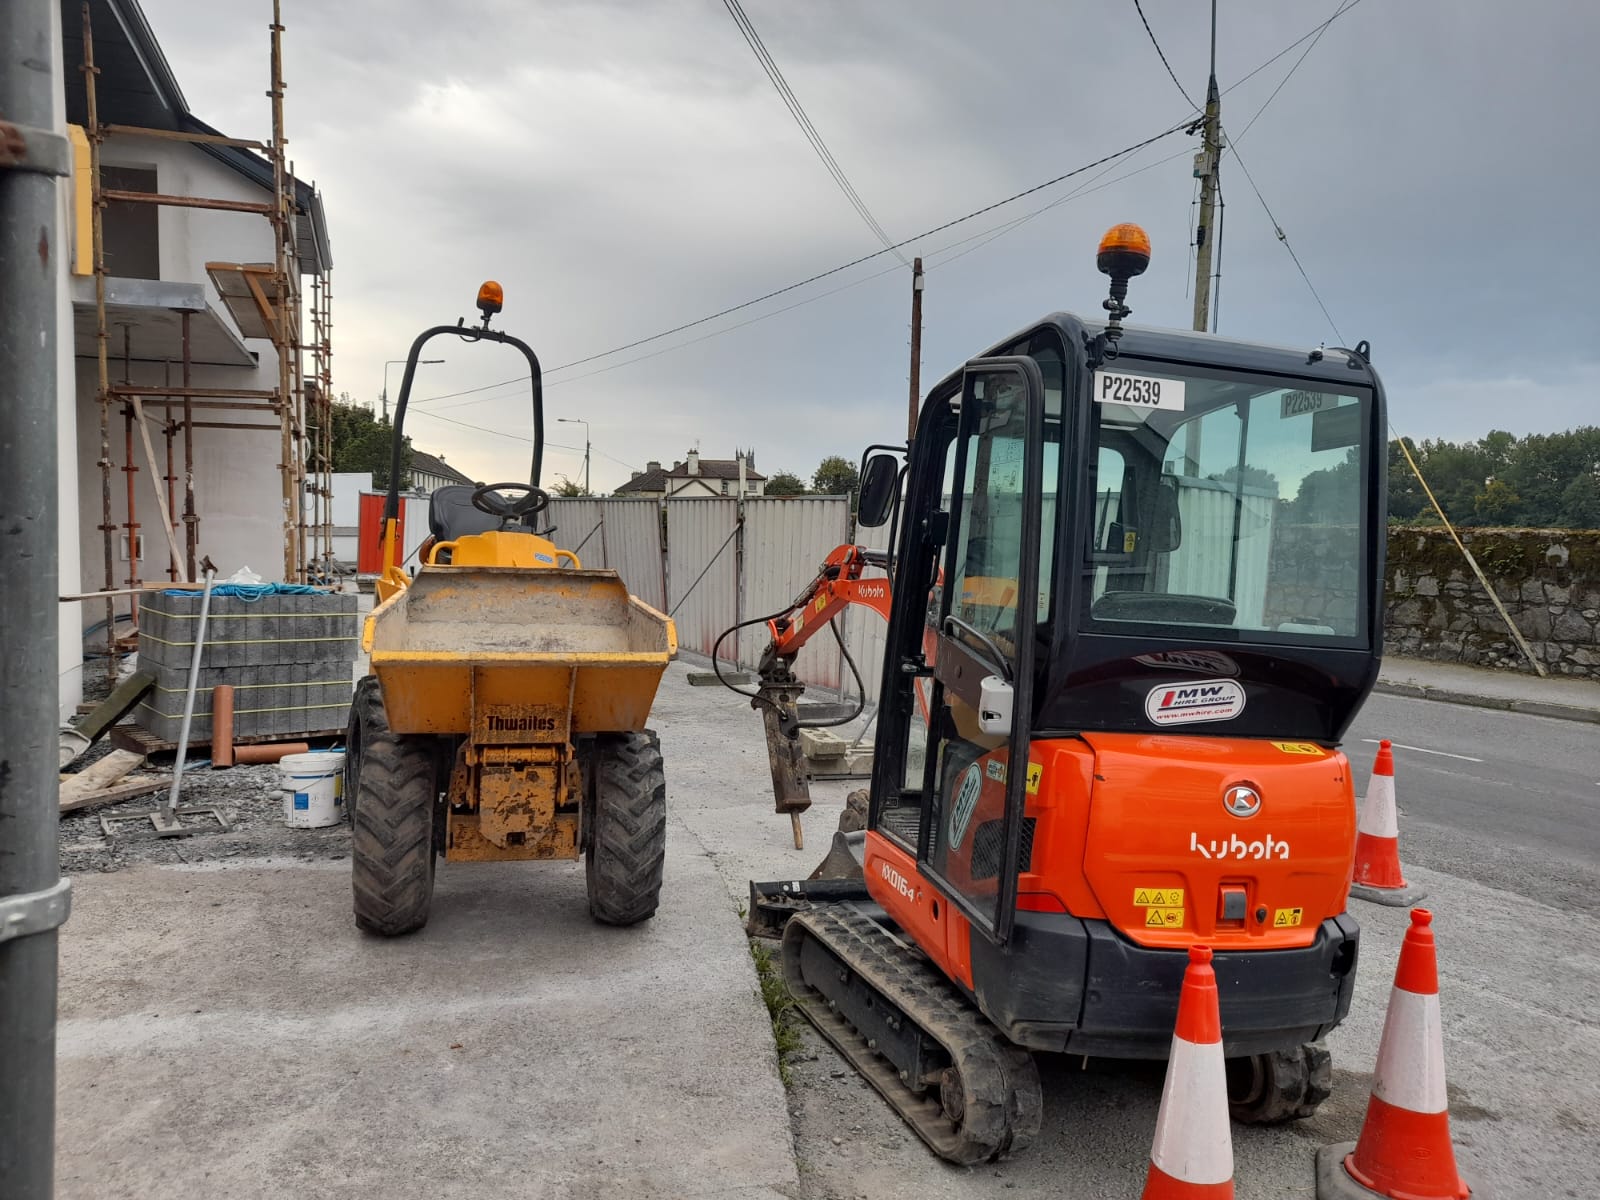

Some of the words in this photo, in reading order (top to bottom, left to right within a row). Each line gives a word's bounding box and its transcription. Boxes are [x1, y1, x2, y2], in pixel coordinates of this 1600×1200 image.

[1102, 376, 1161, 405] P22539
[1174, 698, 1198, 706] HIRE
[1200, 695, 1236, 704] GROUP
[1156, 708, 1233, 720] www.mwhire.com
[486, 715, 555, 731] Thwaites
